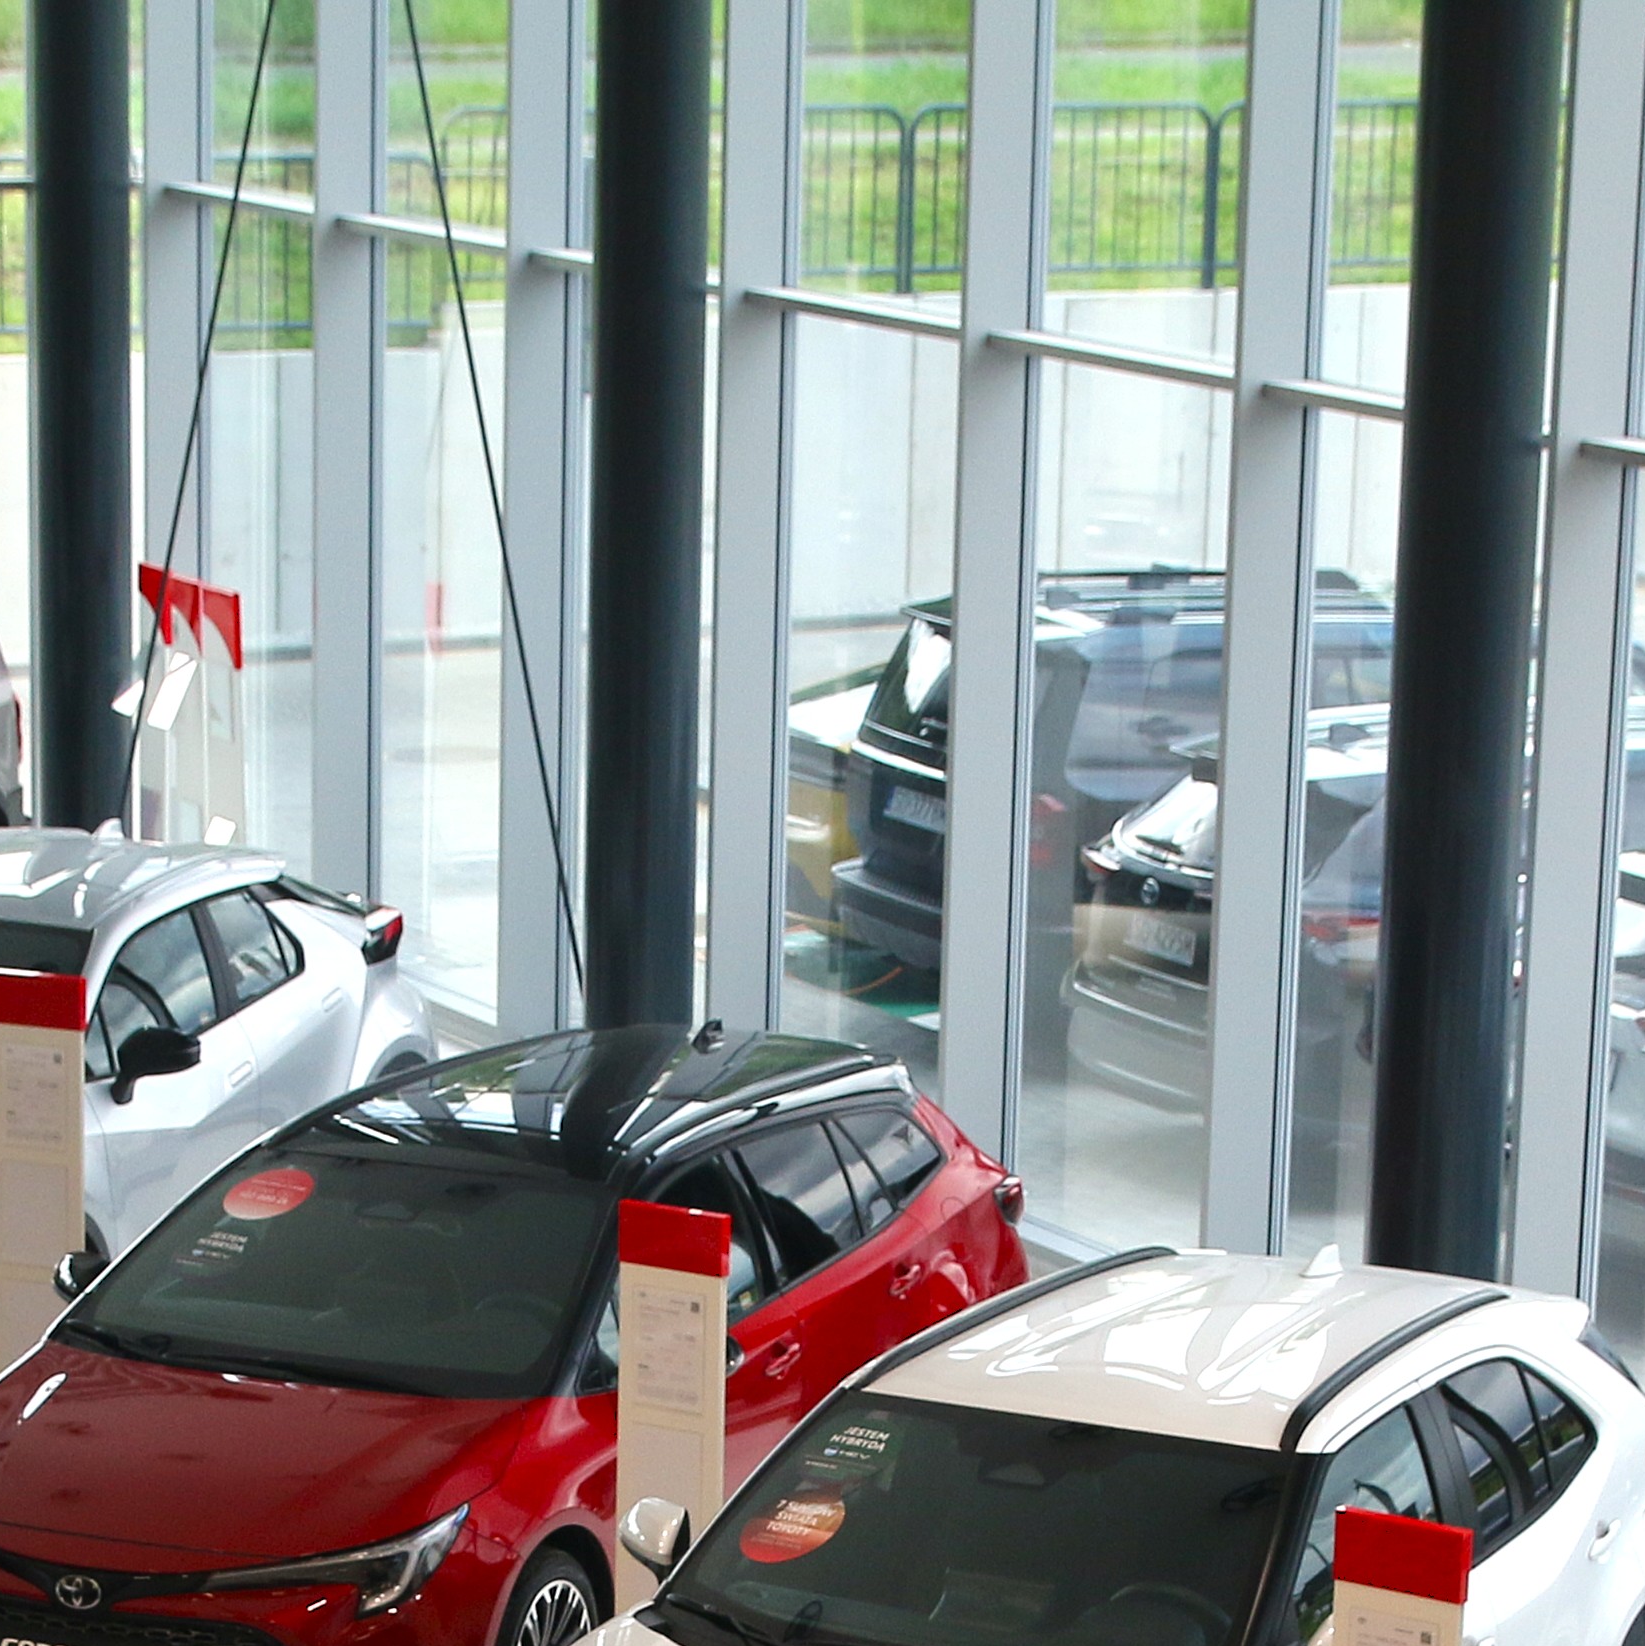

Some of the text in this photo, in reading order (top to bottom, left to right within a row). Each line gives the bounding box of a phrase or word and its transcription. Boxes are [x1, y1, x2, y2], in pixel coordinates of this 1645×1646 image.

[843, 1425, 891, 1442] JESTEM
[776, 1499, 788, 1510] 7
[774, 1510, 819, 1527] ŚWIATA
[766, 1521, 812, 1536] TOYOTY
